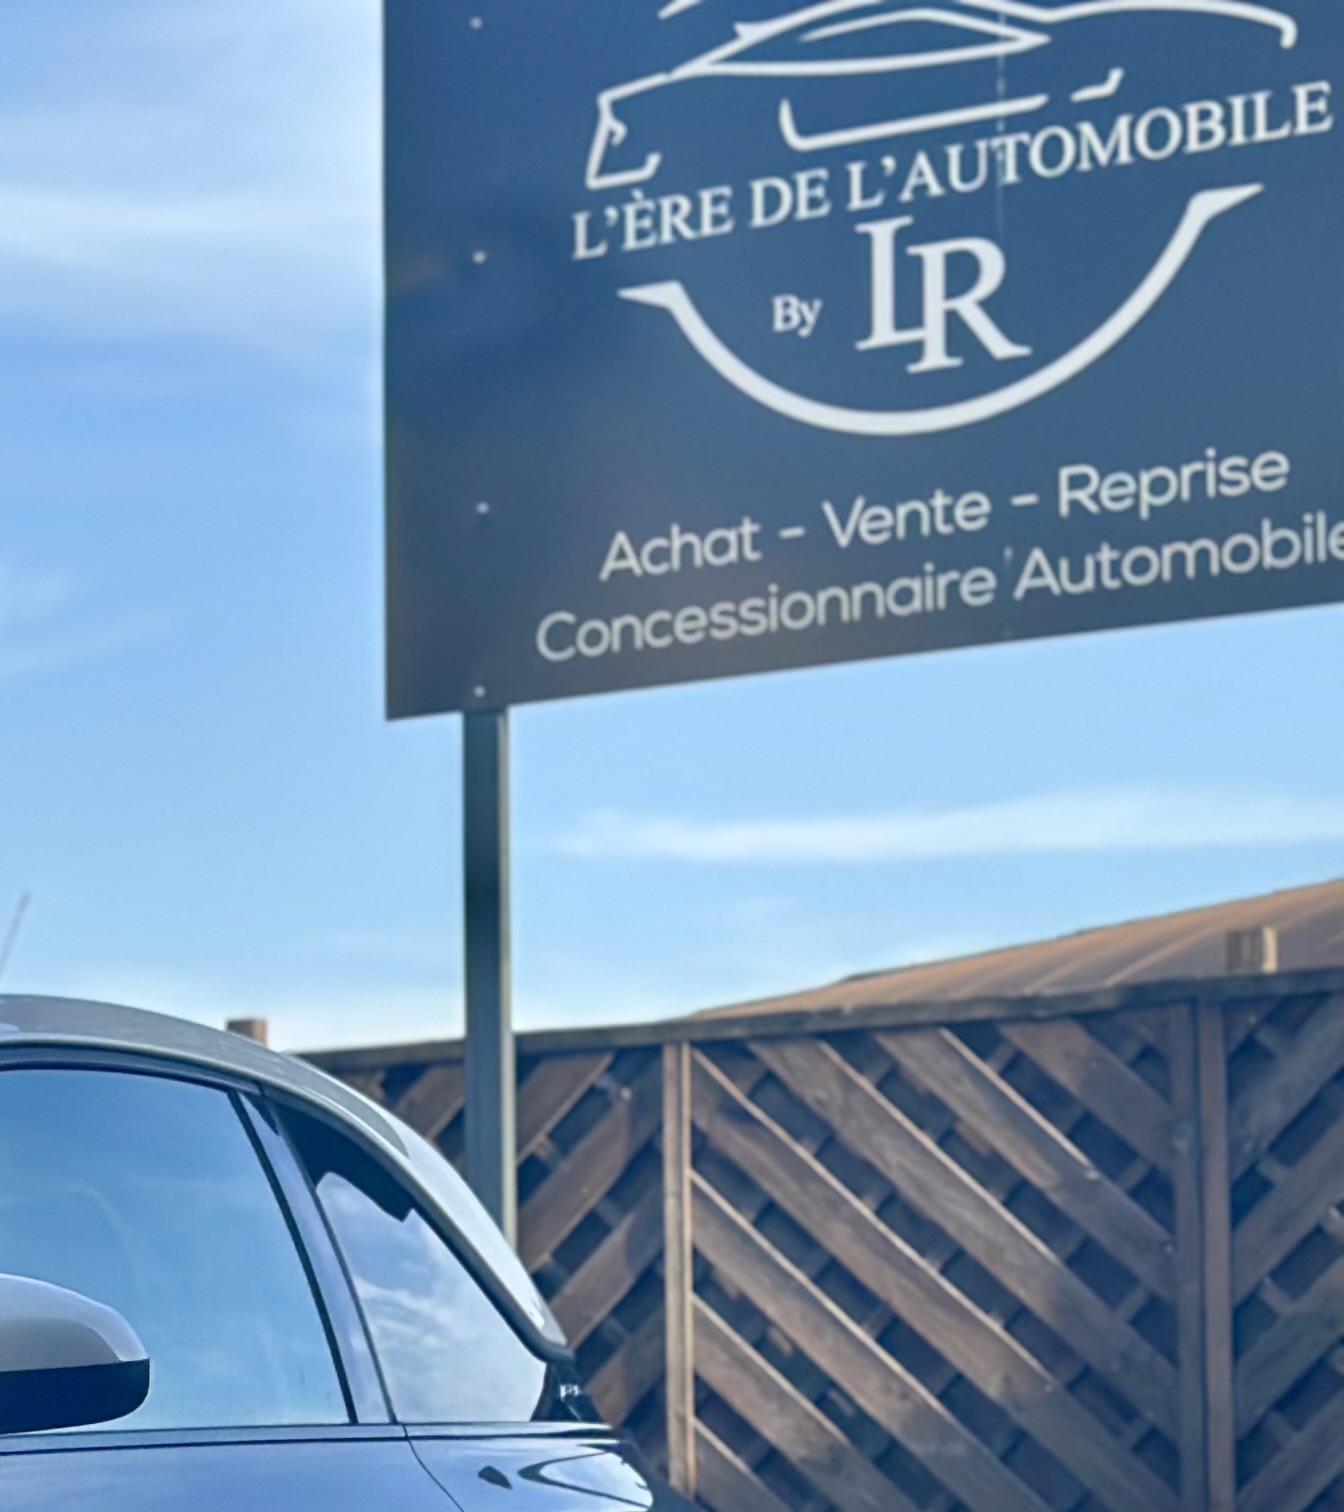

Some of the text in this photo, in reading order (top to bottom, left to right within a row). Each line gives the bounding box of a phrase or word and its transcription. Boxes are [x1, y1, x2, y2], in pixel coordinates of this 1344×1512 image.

[574, 80, 1334, 260] L'ÈRE DE L'AUTOMOBILE
[772, 215, 1033, 375] By LR
[598, 517, 762, 582] Achat
[822, 489, 992, 548] Vente
[1059, 447, 1291, 520] Reprise
[537, 562, 998, 662] Concessionnaire
